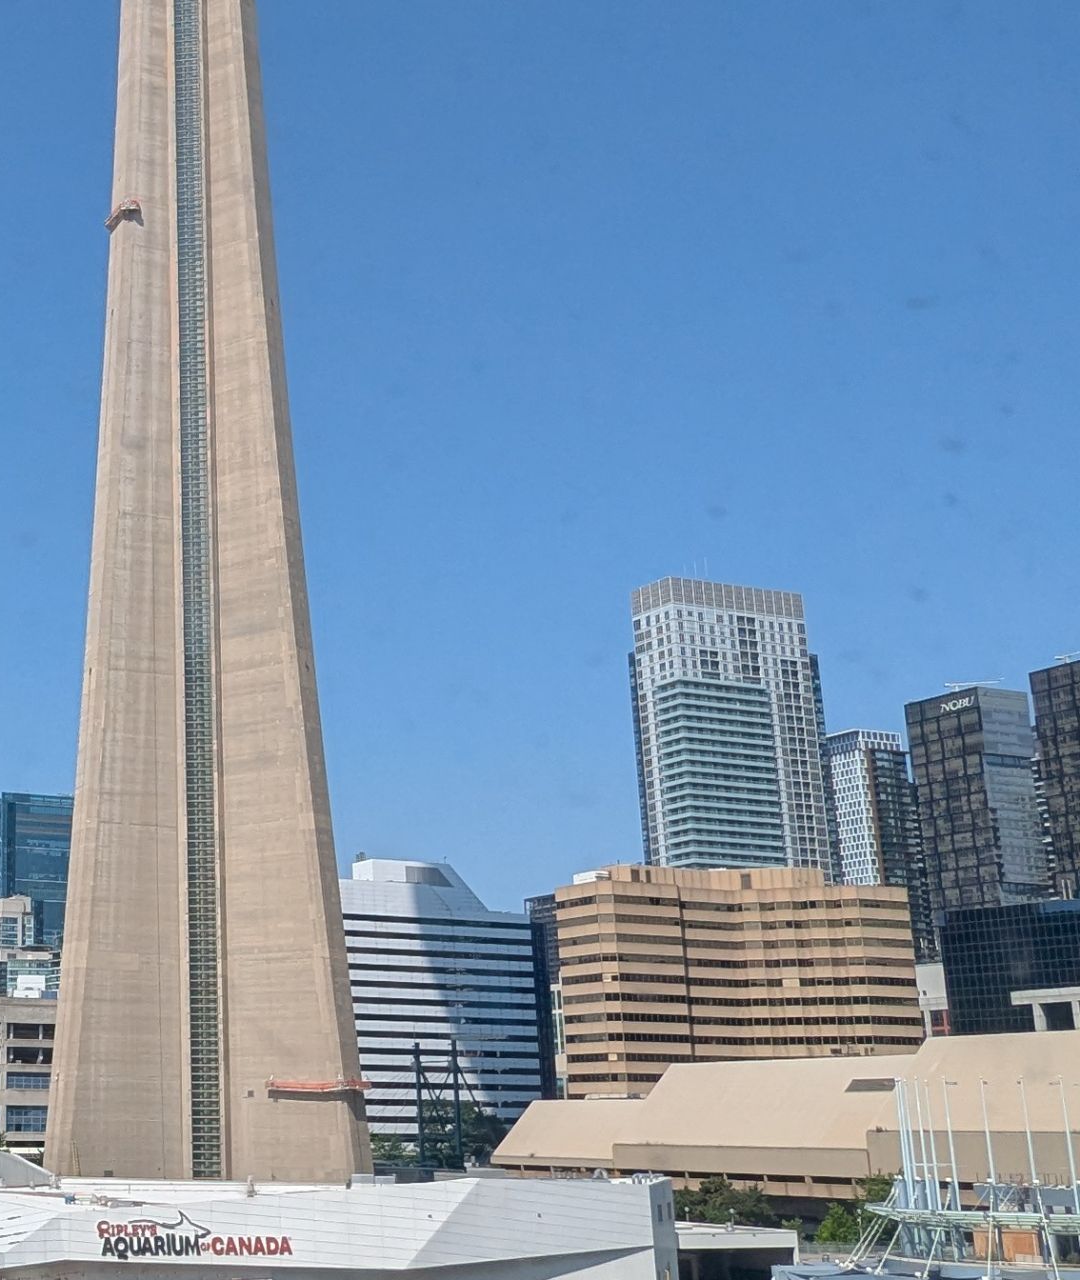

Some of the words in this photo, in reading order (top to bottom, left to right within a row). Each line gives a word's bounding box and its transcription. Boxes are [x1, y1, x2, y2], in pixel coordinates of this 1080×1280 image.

[940, 695, 975, 713] NOBU
[101, 1233, 201, 1260] AQUARIUM
[211, 1236, 293, 1256] CANADA
